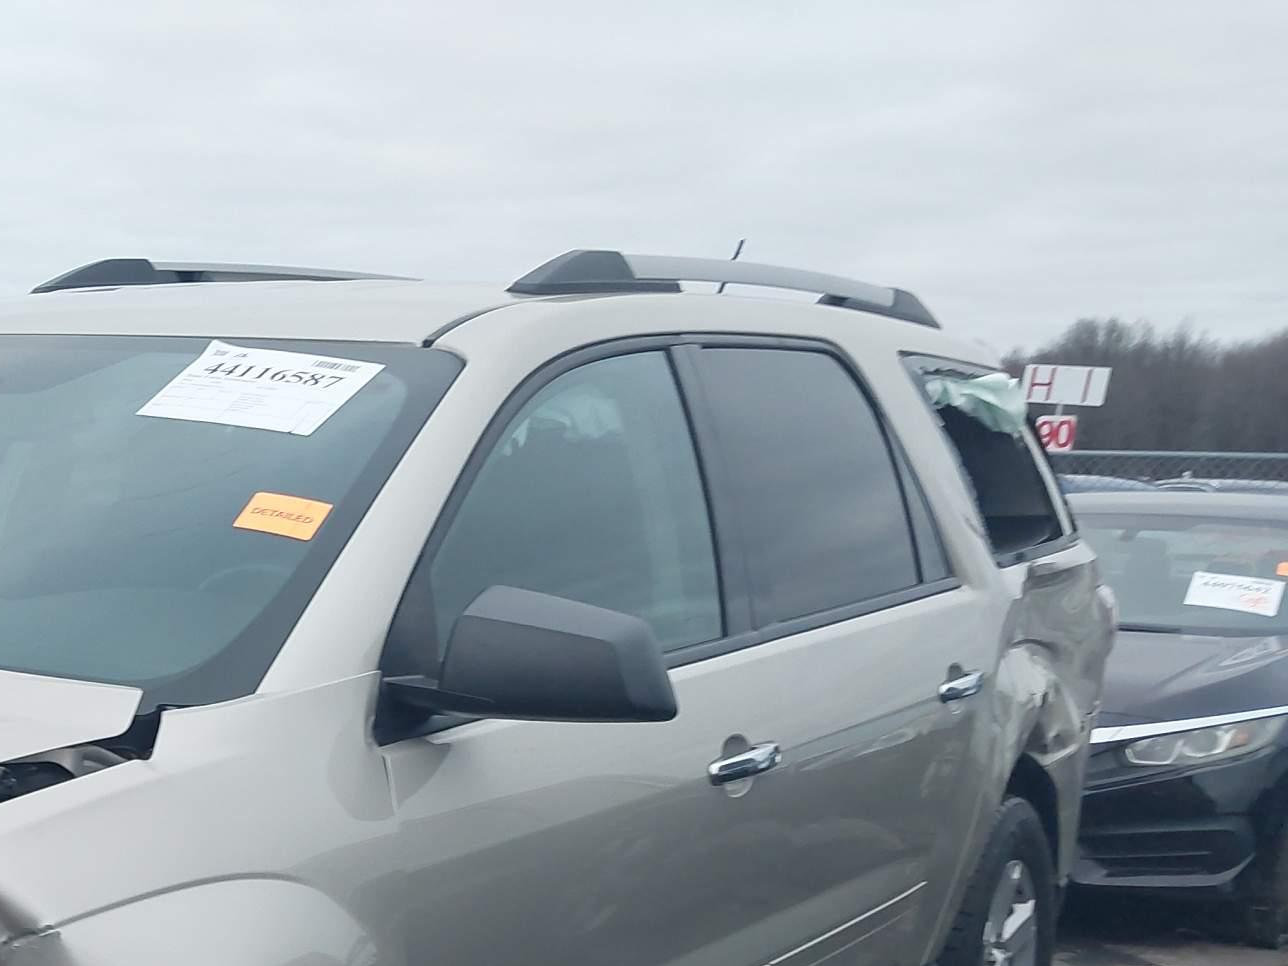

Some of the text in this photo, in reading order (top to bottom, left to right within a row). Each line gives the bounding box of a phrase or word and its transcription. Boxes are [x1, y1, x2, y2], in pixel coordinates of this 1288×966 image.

[204, 362, 346, 389] 44116587
[1026, 366, 1059, 401] H
[250, 507, 314, 524] DETAILED
